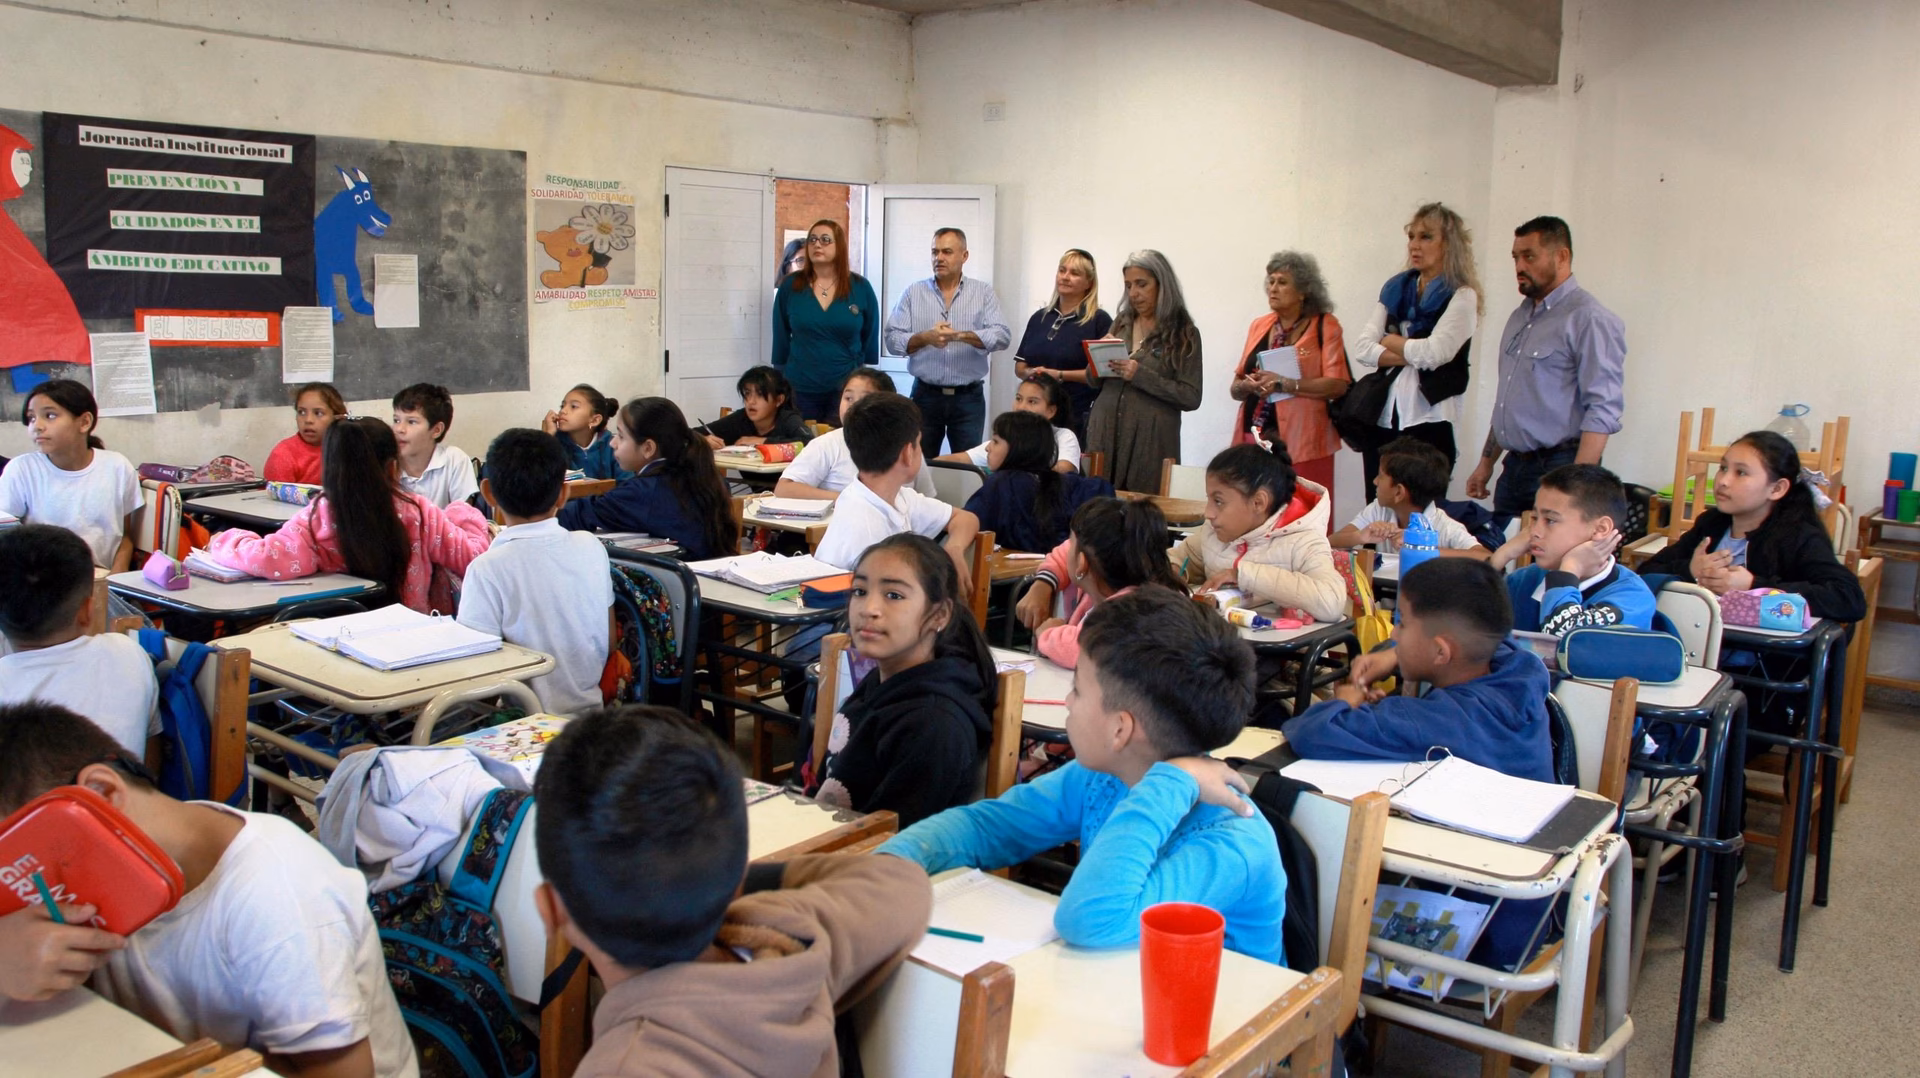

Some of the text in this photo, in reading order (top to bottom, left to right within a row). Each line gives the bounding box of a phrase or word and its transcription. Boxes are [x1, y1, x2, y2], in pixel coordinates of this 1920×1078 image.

[81, 131, 286, 158] Jornada Institucional
[109, 173, 242, 192] PREVENCIÓN Y
[546, 174, 620, 189] RESPONSABILIDAD
[531, 188, 635, 204] SOLIDARIDAD TOLERANCIA
[112, 215, 260, 230] CUIDADOS EN EL
[92, 251, 271, 272] ÁMBITO EDUCATIVO
[535, 288, 657, 300] AMABILIDAD RESPETO AMISTAD
[569, 298, 627, 309] COMPROMISO
[150, 318, 267, 340] EL REGRESO
